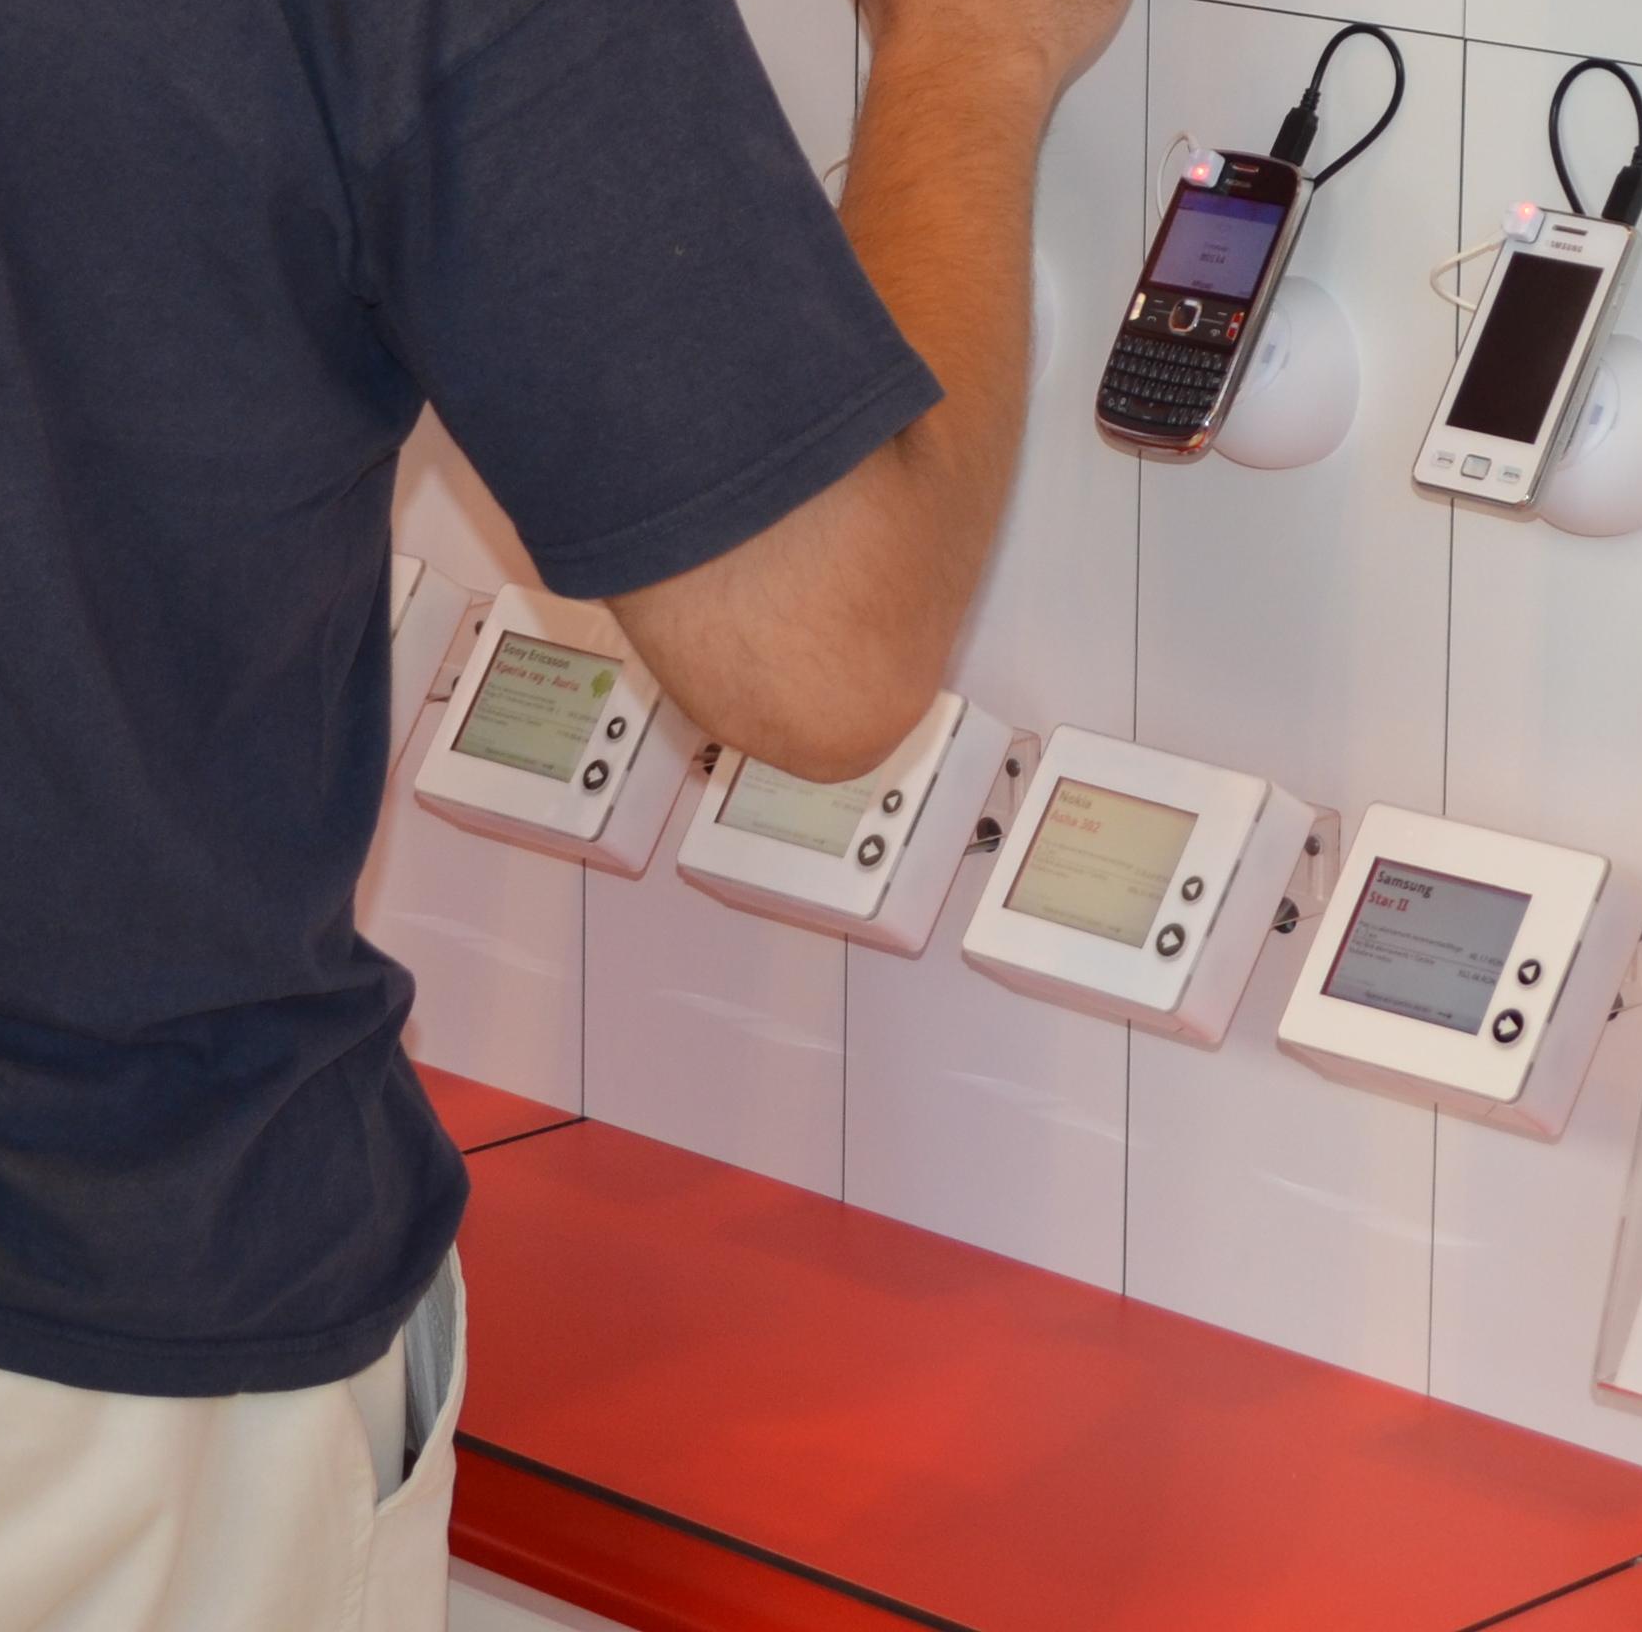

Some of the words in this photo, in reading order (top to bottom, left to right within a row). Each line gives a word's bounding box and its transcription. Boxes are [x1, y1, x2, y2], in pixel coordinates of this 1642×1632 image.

[502, 642, 527, 661] Sony
[1375, 870, 1435, 900] Samsung
[1366, 891, 1394, 910] Star
